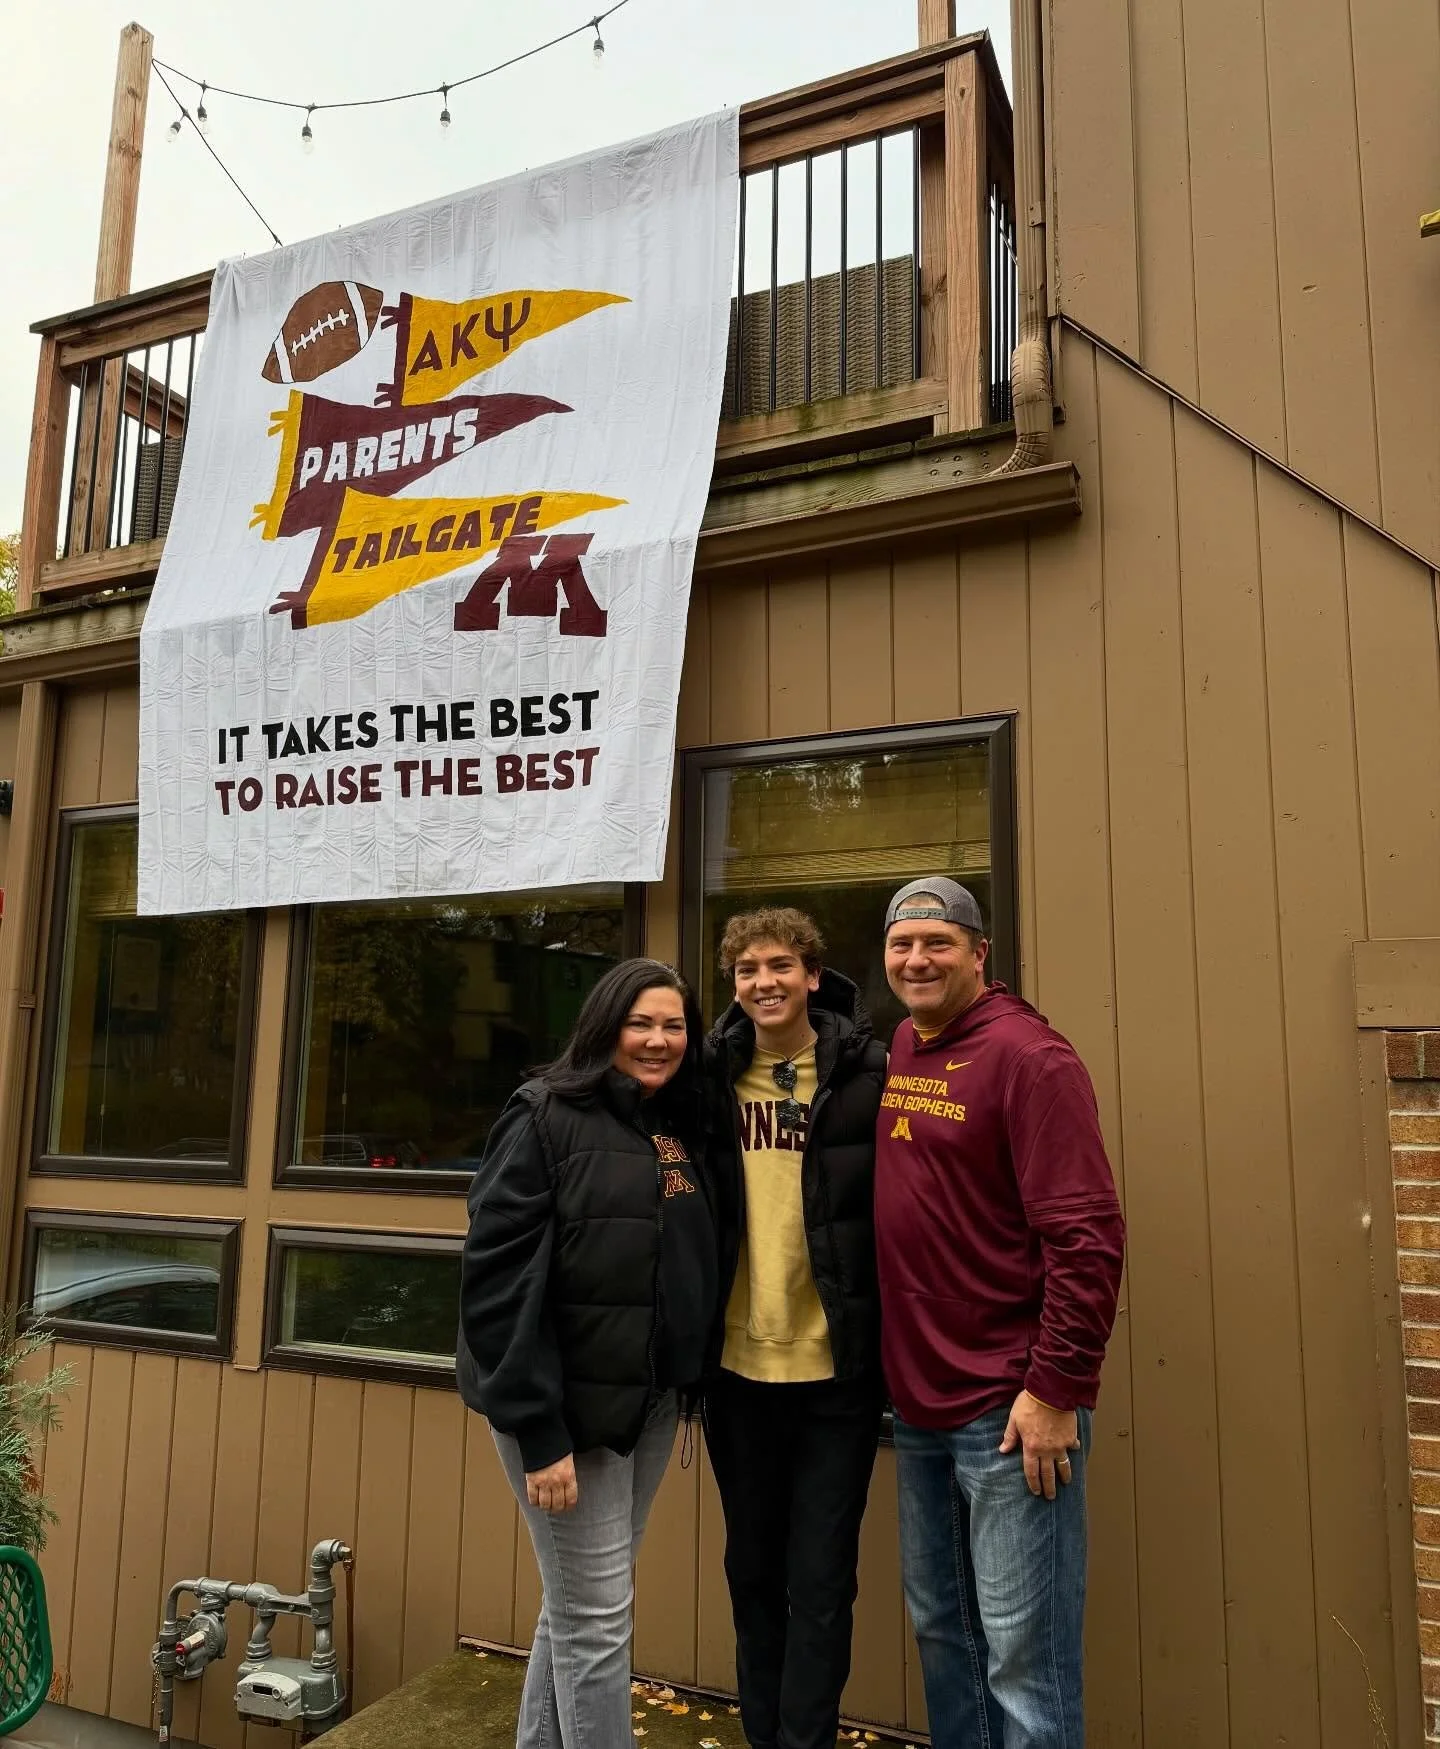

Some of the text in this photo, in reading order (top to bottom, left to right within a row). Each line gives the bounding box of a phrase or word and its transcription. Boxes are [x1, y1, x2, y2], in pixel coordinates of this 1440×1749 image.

[300, 408, 479, 490] PARENTS
[332, 496, 543, 573] TAILGATE
[454, 533, 608, 637] M
[218, 690, 599, 764] IT TAKES THE BEST
[215, 747, 600, 815] TO RAISE THE BEST
[887, 1074, 948, 1096] MINNESOTA
[904, 1095, 966, 1121] GOPHERS
